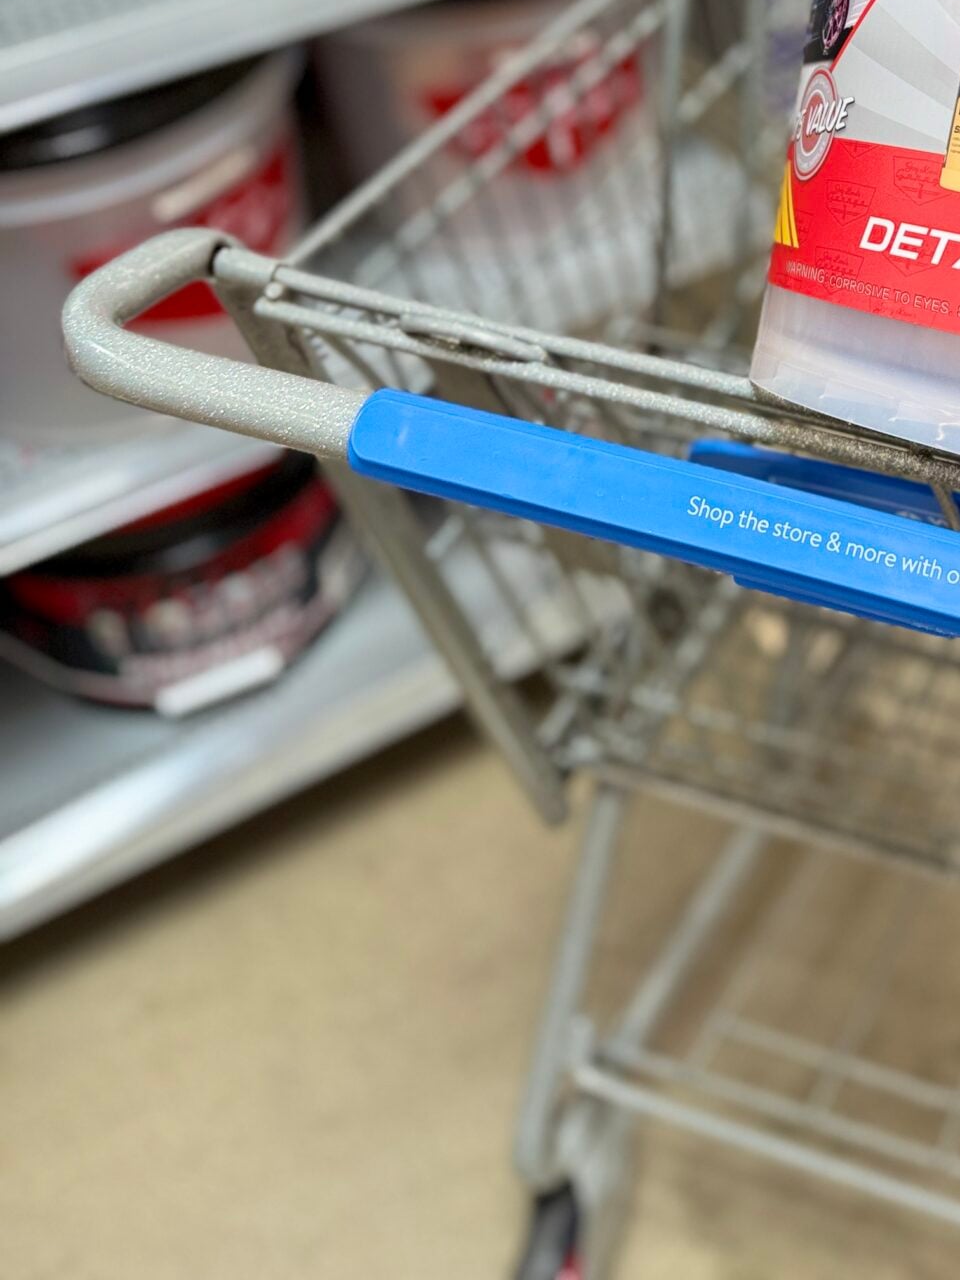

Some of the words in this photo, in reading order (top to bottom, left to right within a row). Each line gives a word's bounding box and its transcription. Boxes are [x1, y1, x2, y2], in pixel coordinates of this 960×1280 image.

[805, 96, 855, 138] VALUE
[829, 275, 891, 301] CORROSIVE
[894, 289, 910, 305] TO
[686, 495, 734, 528] Shop
[738, 508, 769, 534] the
[773, 521, 822, 549] store
[826, 532, 841, 554] &
[845, 542, 898, 569] more
[901, 553, 944, 580] with
